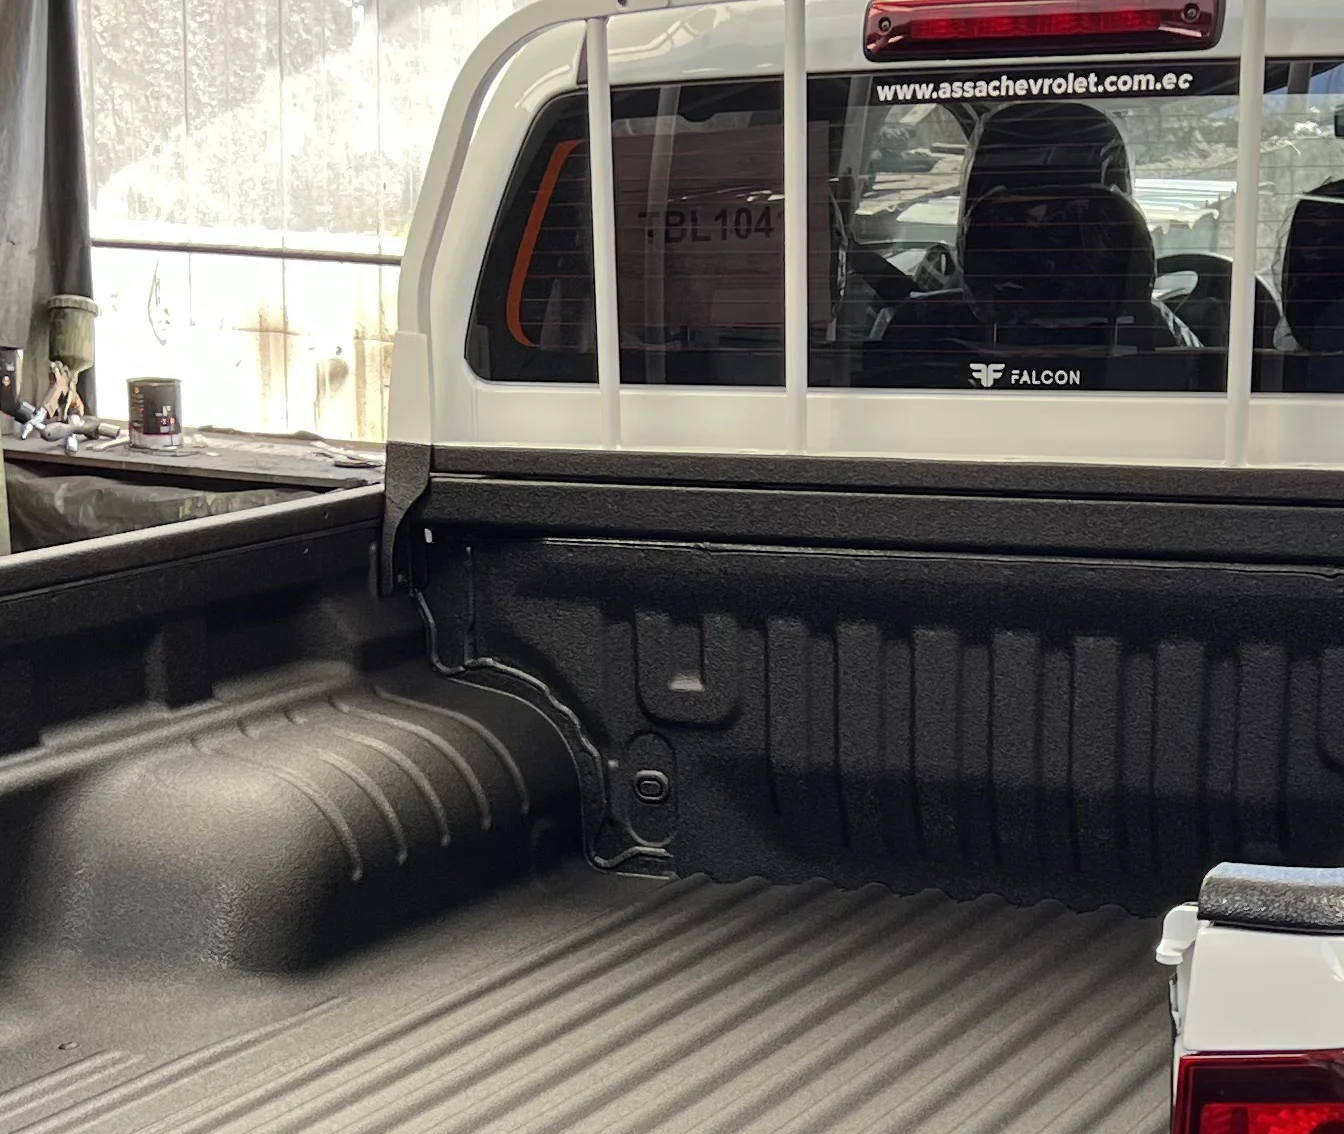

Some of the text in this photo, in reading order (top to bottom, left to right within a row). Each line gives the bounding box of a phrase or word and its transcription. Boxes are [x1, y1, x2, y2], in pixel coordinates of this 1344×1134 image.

[877, 73, 1193, 101] www.assachevrolet.com.ec
[637, 206, 784, 243] TBL104
[1011, 370, 1081, 385] FALCON
